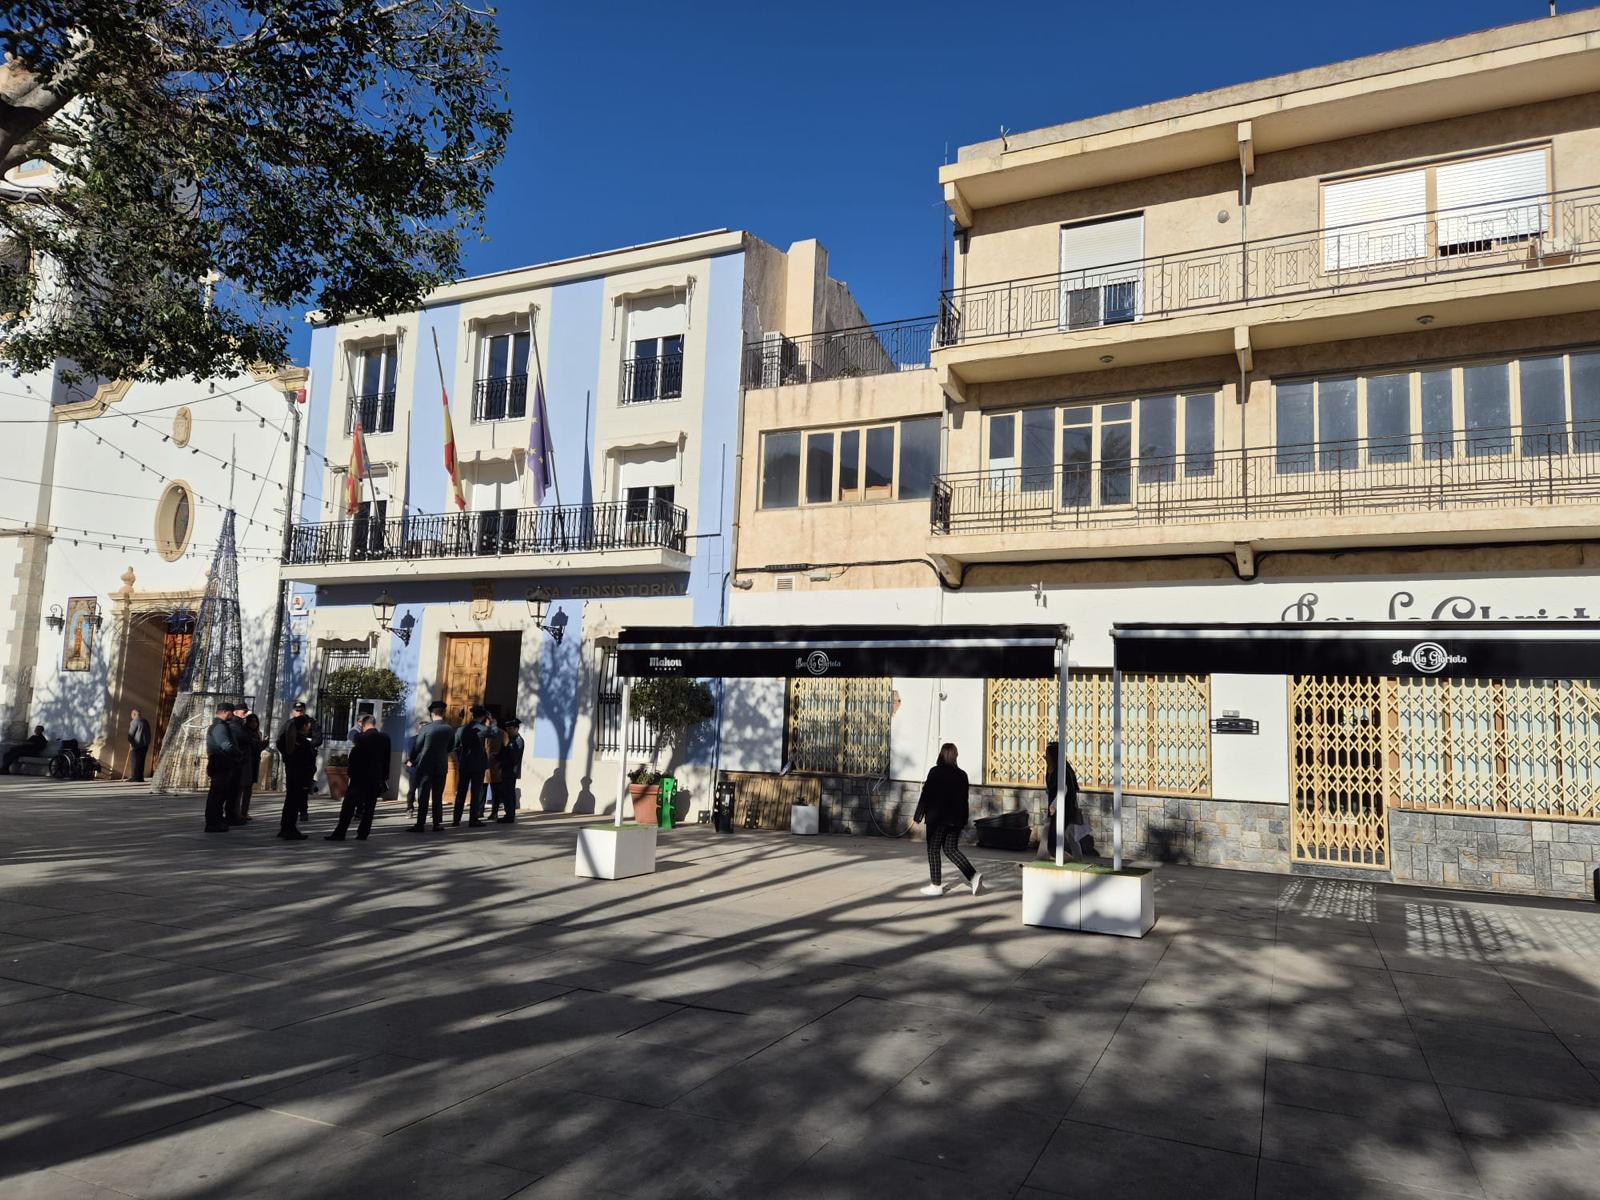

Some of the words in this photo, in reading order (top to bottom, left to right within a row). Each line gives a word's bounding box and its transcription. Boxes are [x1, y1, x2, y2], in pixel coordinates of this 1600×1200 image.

[524, 587, 560, 598] CSA
[649, 656, 682, 667] Mahou
[1391, 650, 1412, 665] Bar
[1415, 650, 1427, 666] La
